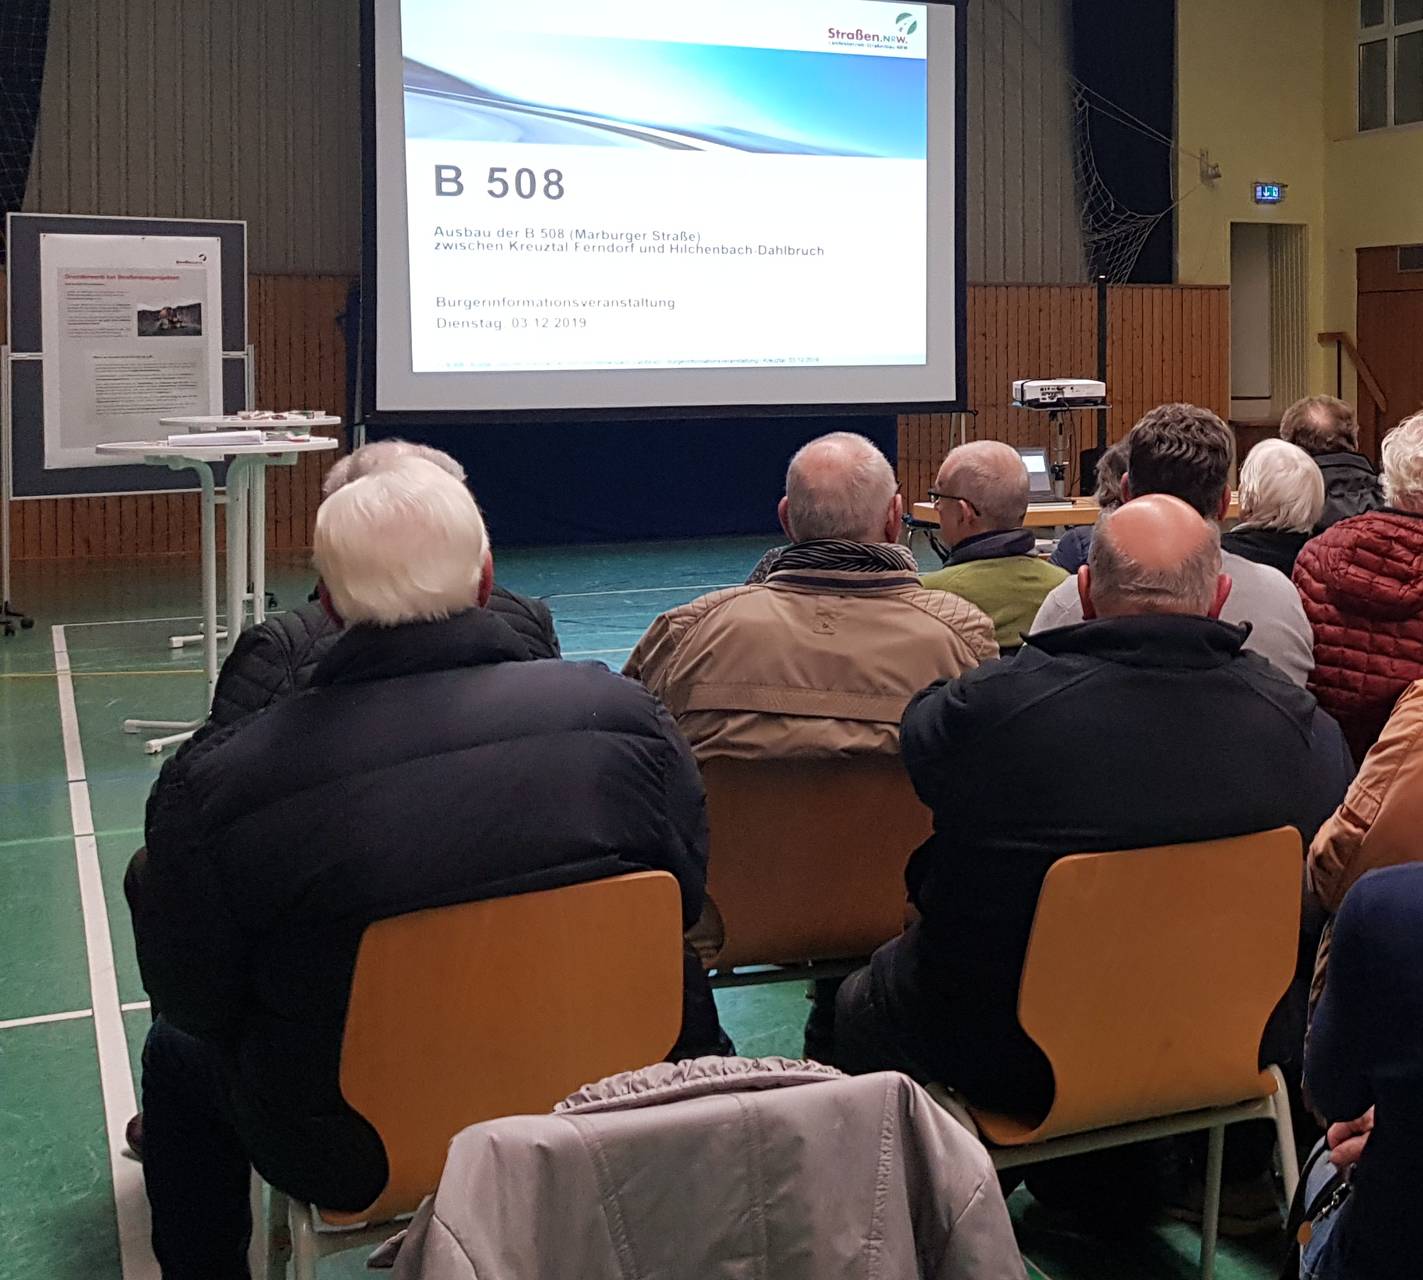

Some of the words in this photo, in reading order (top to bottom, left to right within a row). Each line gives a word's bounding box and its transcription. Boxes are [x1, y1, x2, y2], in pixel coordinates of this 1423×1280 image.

[435, 164, 464, 196] B
[487, 167, 565, 200] 508
[434, 226, 491, 238] Ausbau
[496, 227, 520, 239] der
[525, 227, 535, 239] B
[540, 228, 565, 239] 508
[570, 229, 647, 243] (Marburger
[652, 230, 701, 245] Straße)
[434, 241, 503, 251] zwischen
[639, 243, 665, 254] und
